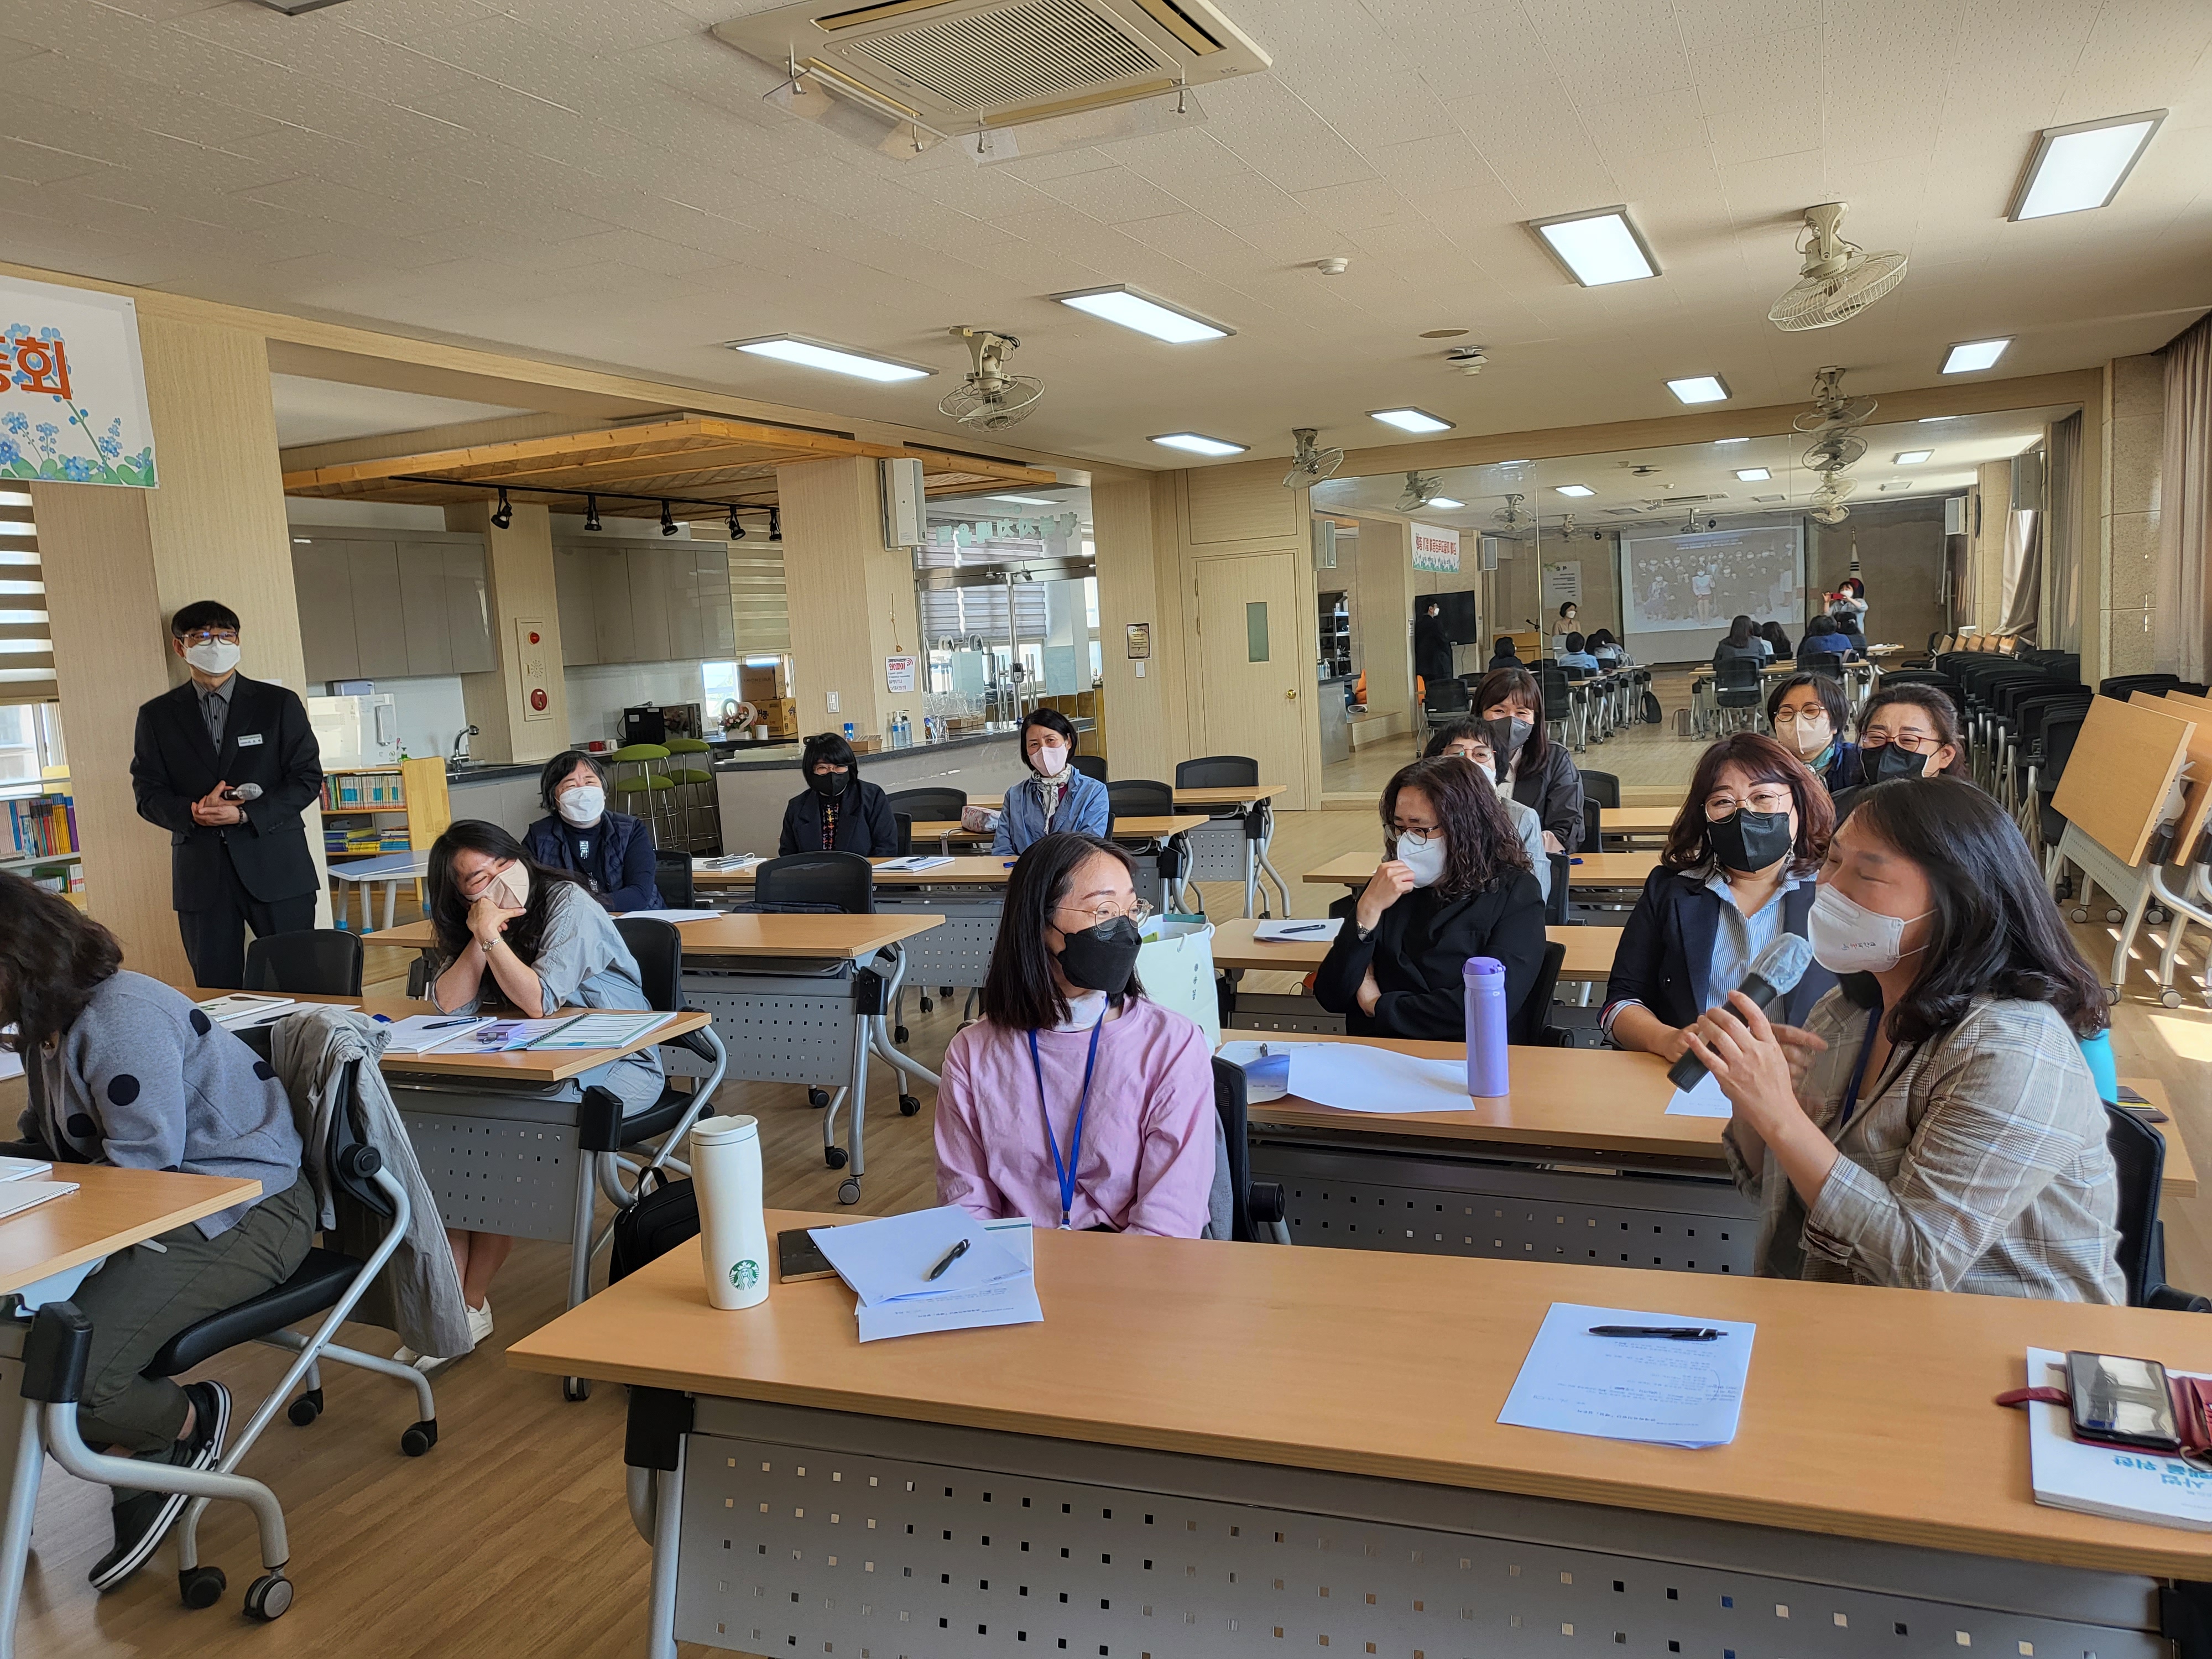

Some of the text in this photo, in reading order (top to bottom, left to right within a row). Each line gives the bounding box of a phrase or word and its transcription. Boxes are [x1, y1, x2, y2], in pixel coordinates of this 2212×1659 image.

[0, 336, 72, 400] 회
[889, 662, 905, 671] 와이파이
[758, 709, 769, 720] 리퐁
[2111, 1454, 2157, 1470] 위한
